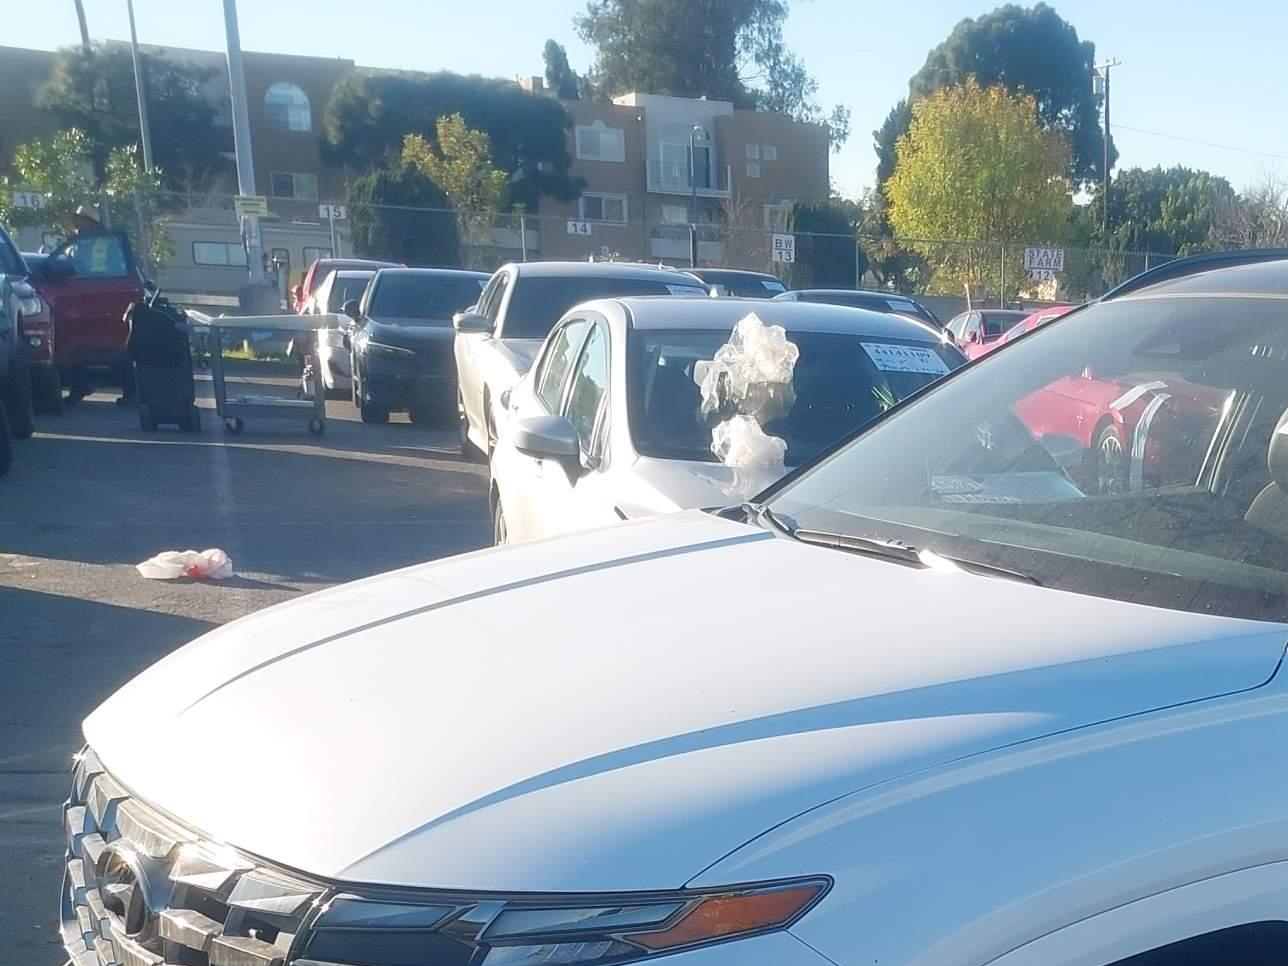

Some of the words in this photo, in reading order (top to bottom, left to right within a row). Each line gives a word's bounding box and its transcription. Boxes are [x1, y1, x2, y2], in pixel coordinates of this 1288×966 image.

[20, 195, 40, 207] 16
[325, 205, 342, 218] 15
[571, 223, 587, 233] 14
[775, 238, 793, 249] BW
[777, 250, 792, 261] 13
[1028, 249, 1063, 259] STATE
[1029, 257, 1061, 268] FARM
[1036, 271, 1050, 281] 12
